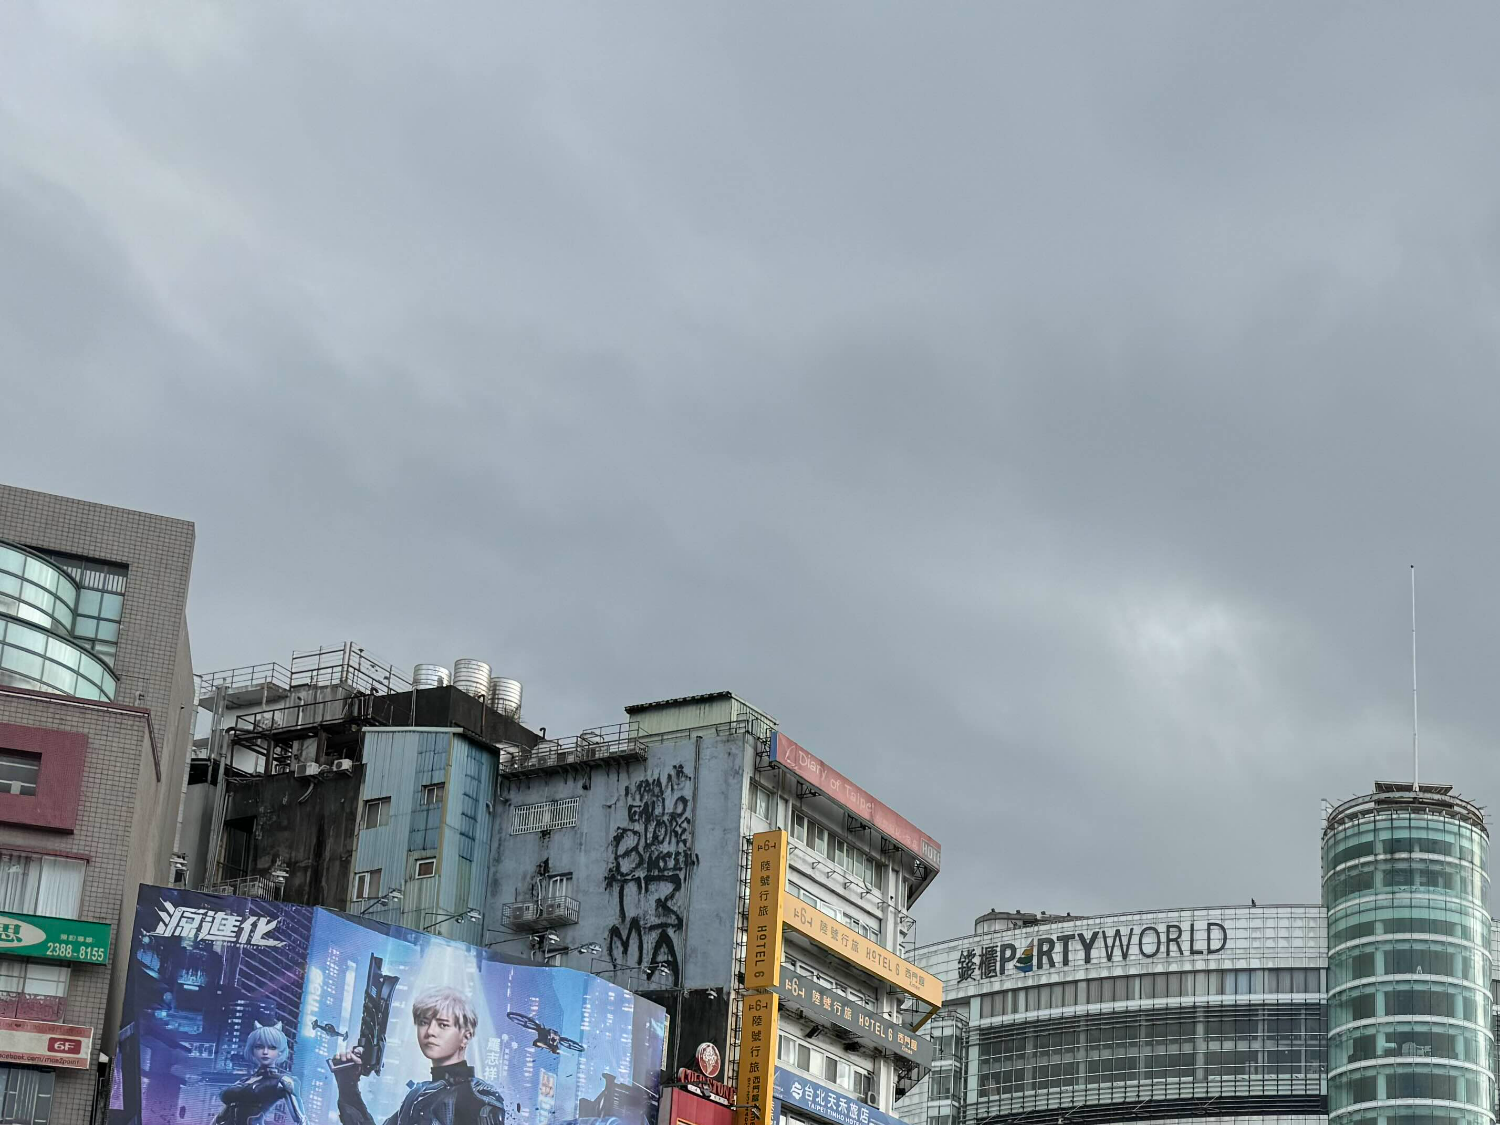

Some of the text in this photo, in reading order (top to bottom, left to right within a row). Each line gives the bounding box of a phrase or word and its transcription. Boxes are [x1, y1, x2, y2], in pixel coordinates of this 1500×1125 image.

[798, 750, 875, 815] Diary of Taipei
[46, 942, 104, 961] 2388-8155
[54, 1041, 76, 1051] 6F
[804, 1083, 869, 1125] 台北天禾旅店
